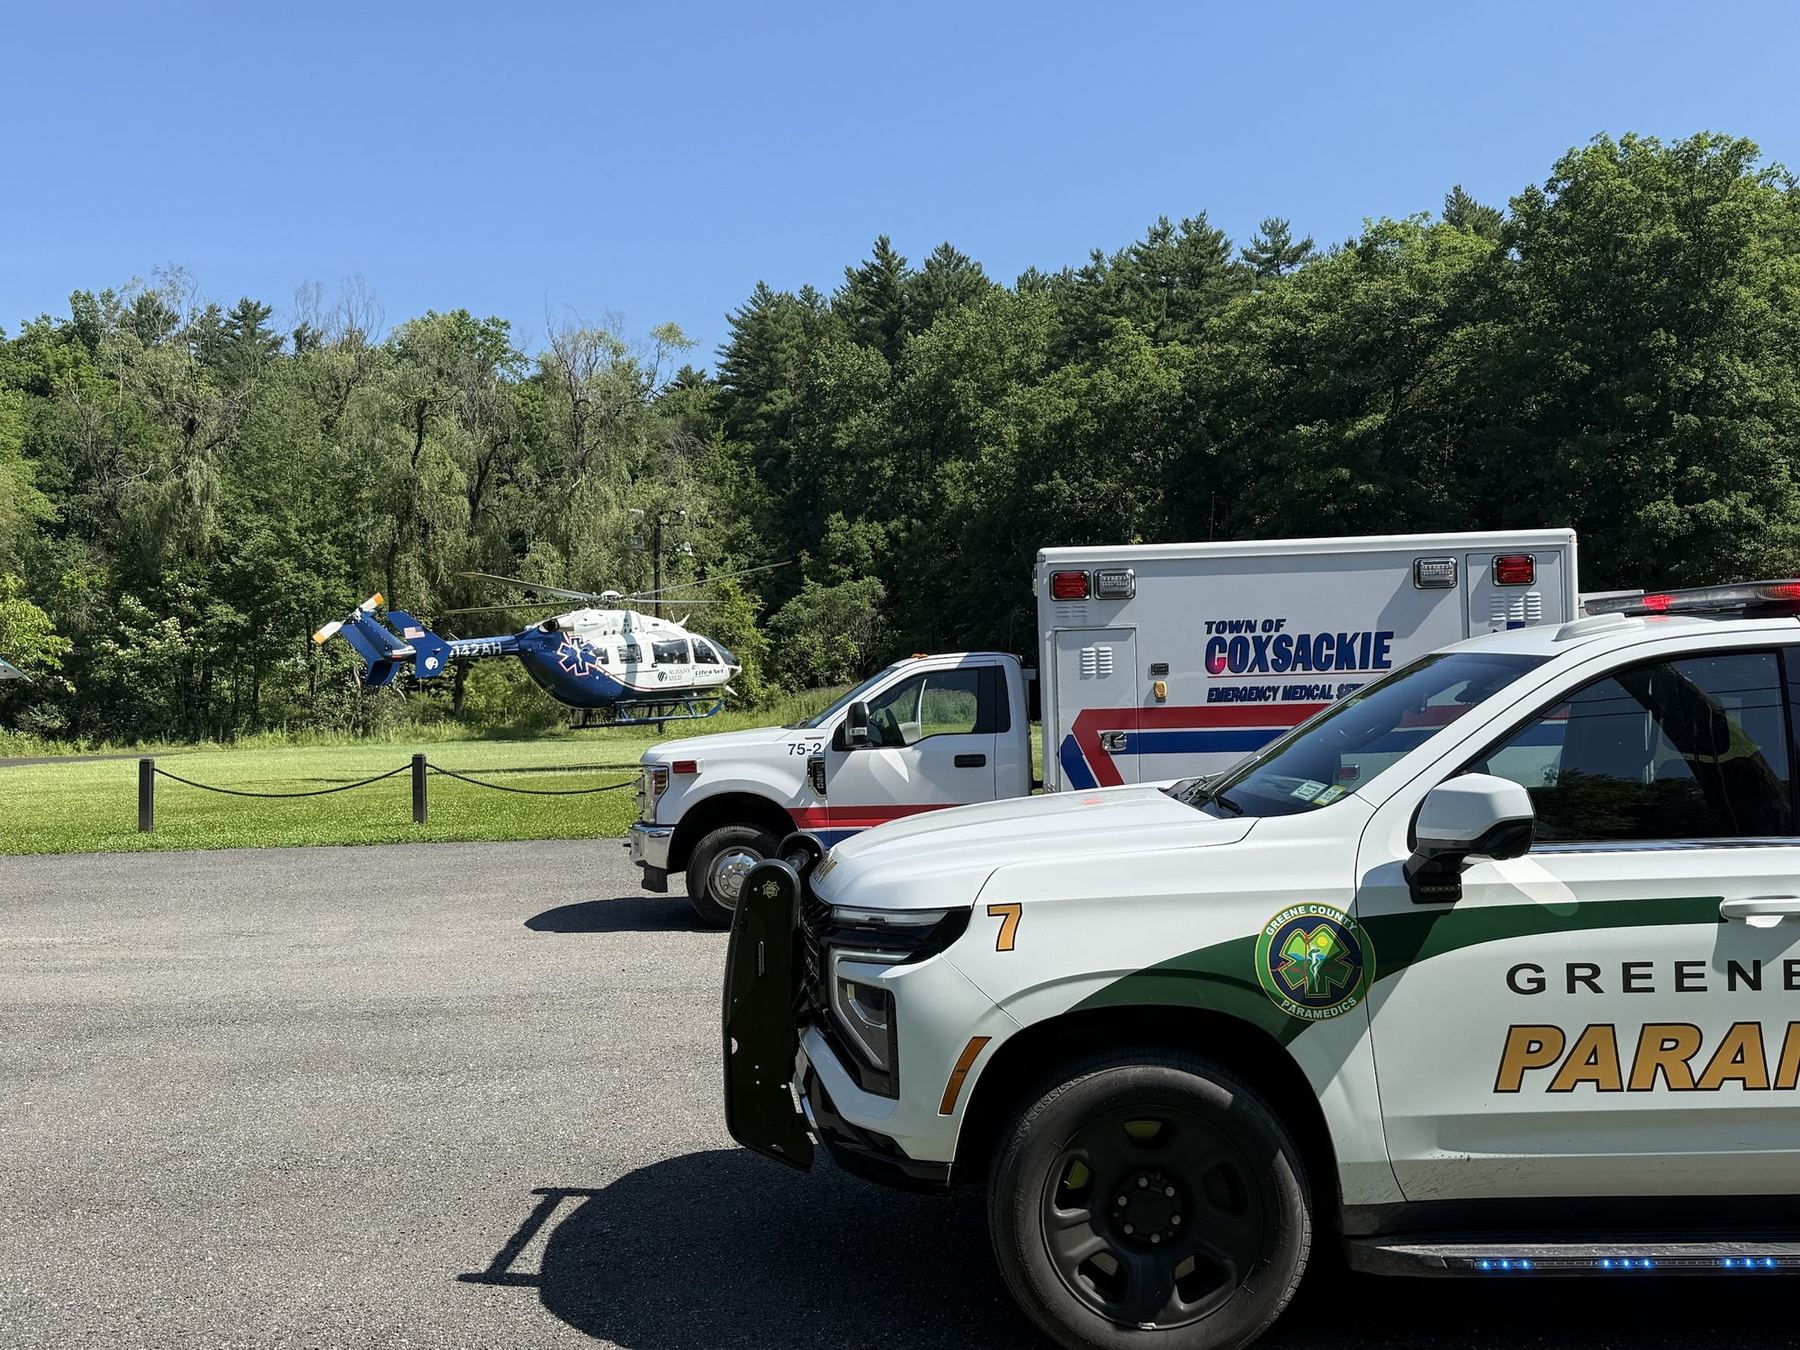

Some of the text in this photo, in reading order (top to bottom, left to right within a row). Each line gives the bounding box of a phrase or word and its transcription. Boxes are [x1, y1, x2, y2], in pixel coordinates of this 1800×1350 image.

[1204, 619, 1286, 634] TOWN OF
[1204, 631, 1394, 674] COXSACKIE
[1207, 686, 1280, 702] EMERGENCY
[1281, 684, 1333, 701] MEDICAL
[787, 742, 822, 755] 75-2
[987, 902, 1023, 952] 7
[1265, 905, 1358, 936] GREENE COUNTY
[1281, 997, 1357, 1019] PARAMEDICS
